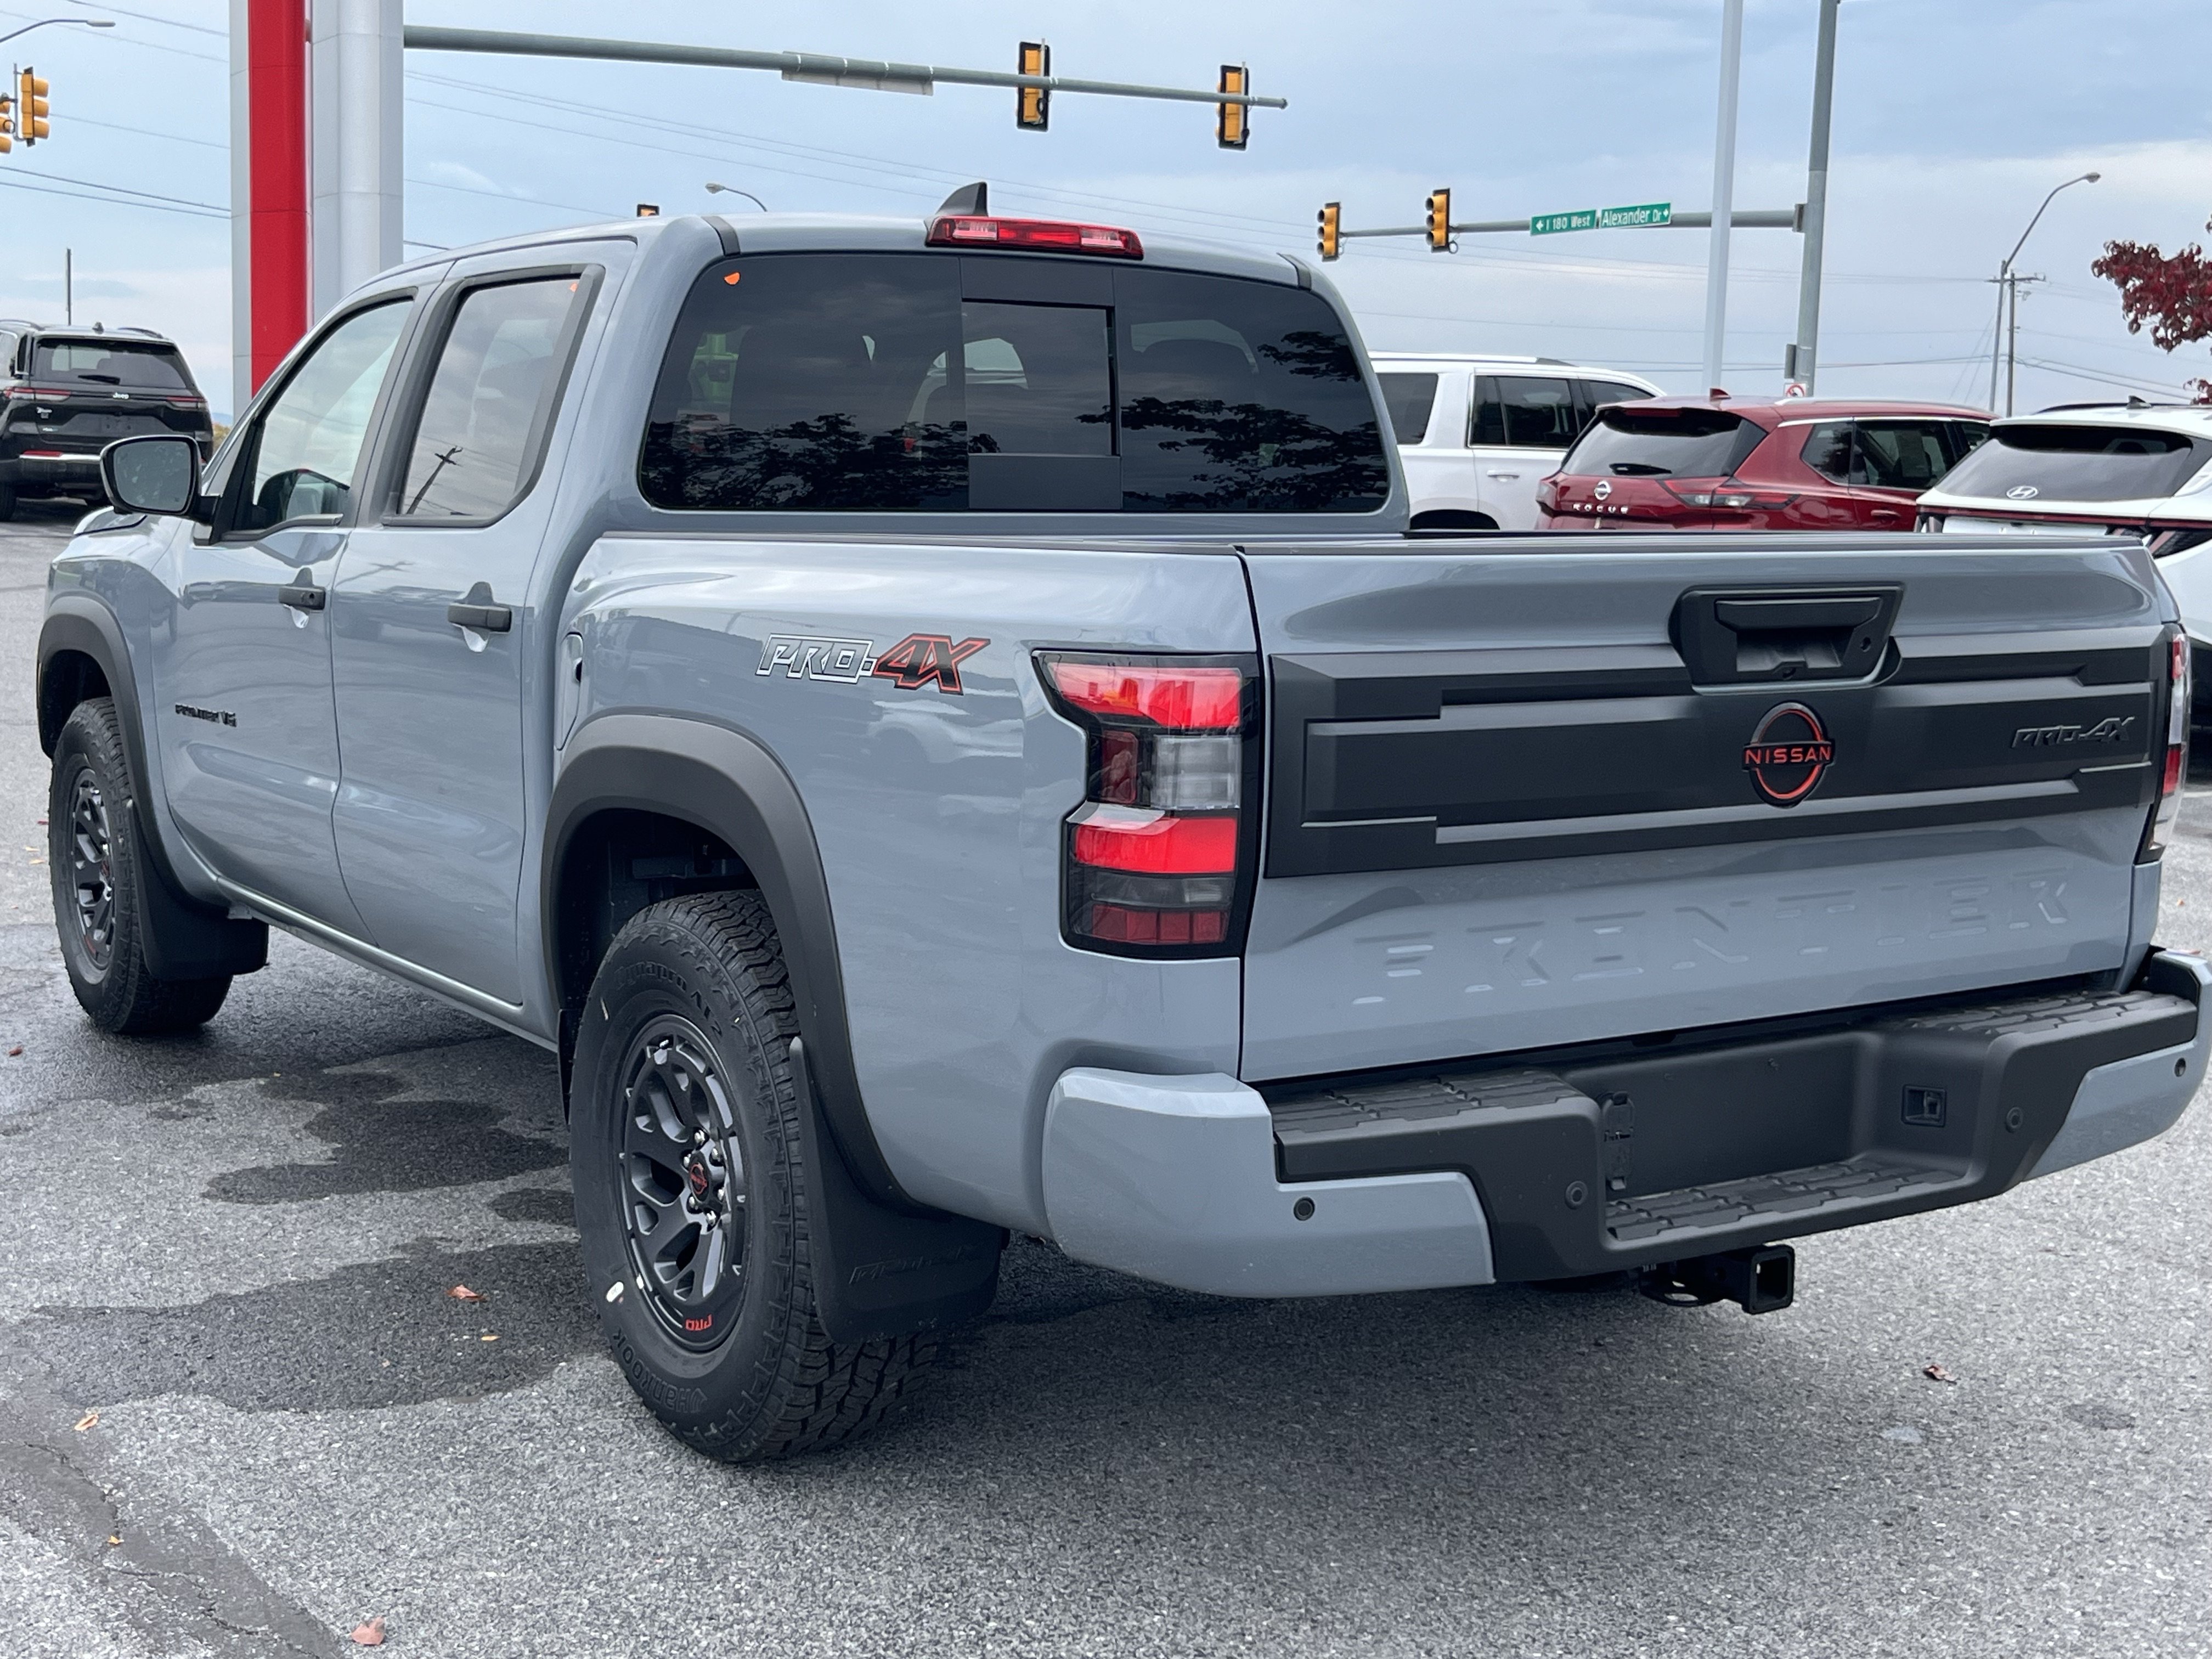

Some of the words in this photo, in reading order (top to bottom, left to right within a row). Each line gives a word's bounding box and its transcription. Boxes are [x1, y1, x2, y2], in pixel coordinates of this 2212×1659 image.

[1546, 220, 1550, 230] I
[1553, 217, 1567, 230] 180
[1570, 215, 1590, 228] West
[1601, 207, 1650, 226] Alexander
[1652, 209, 1661, 221] Dr
[1744, 746, 1831, 764] NISSAN
[685, 1314, 713, 1331] PRO
